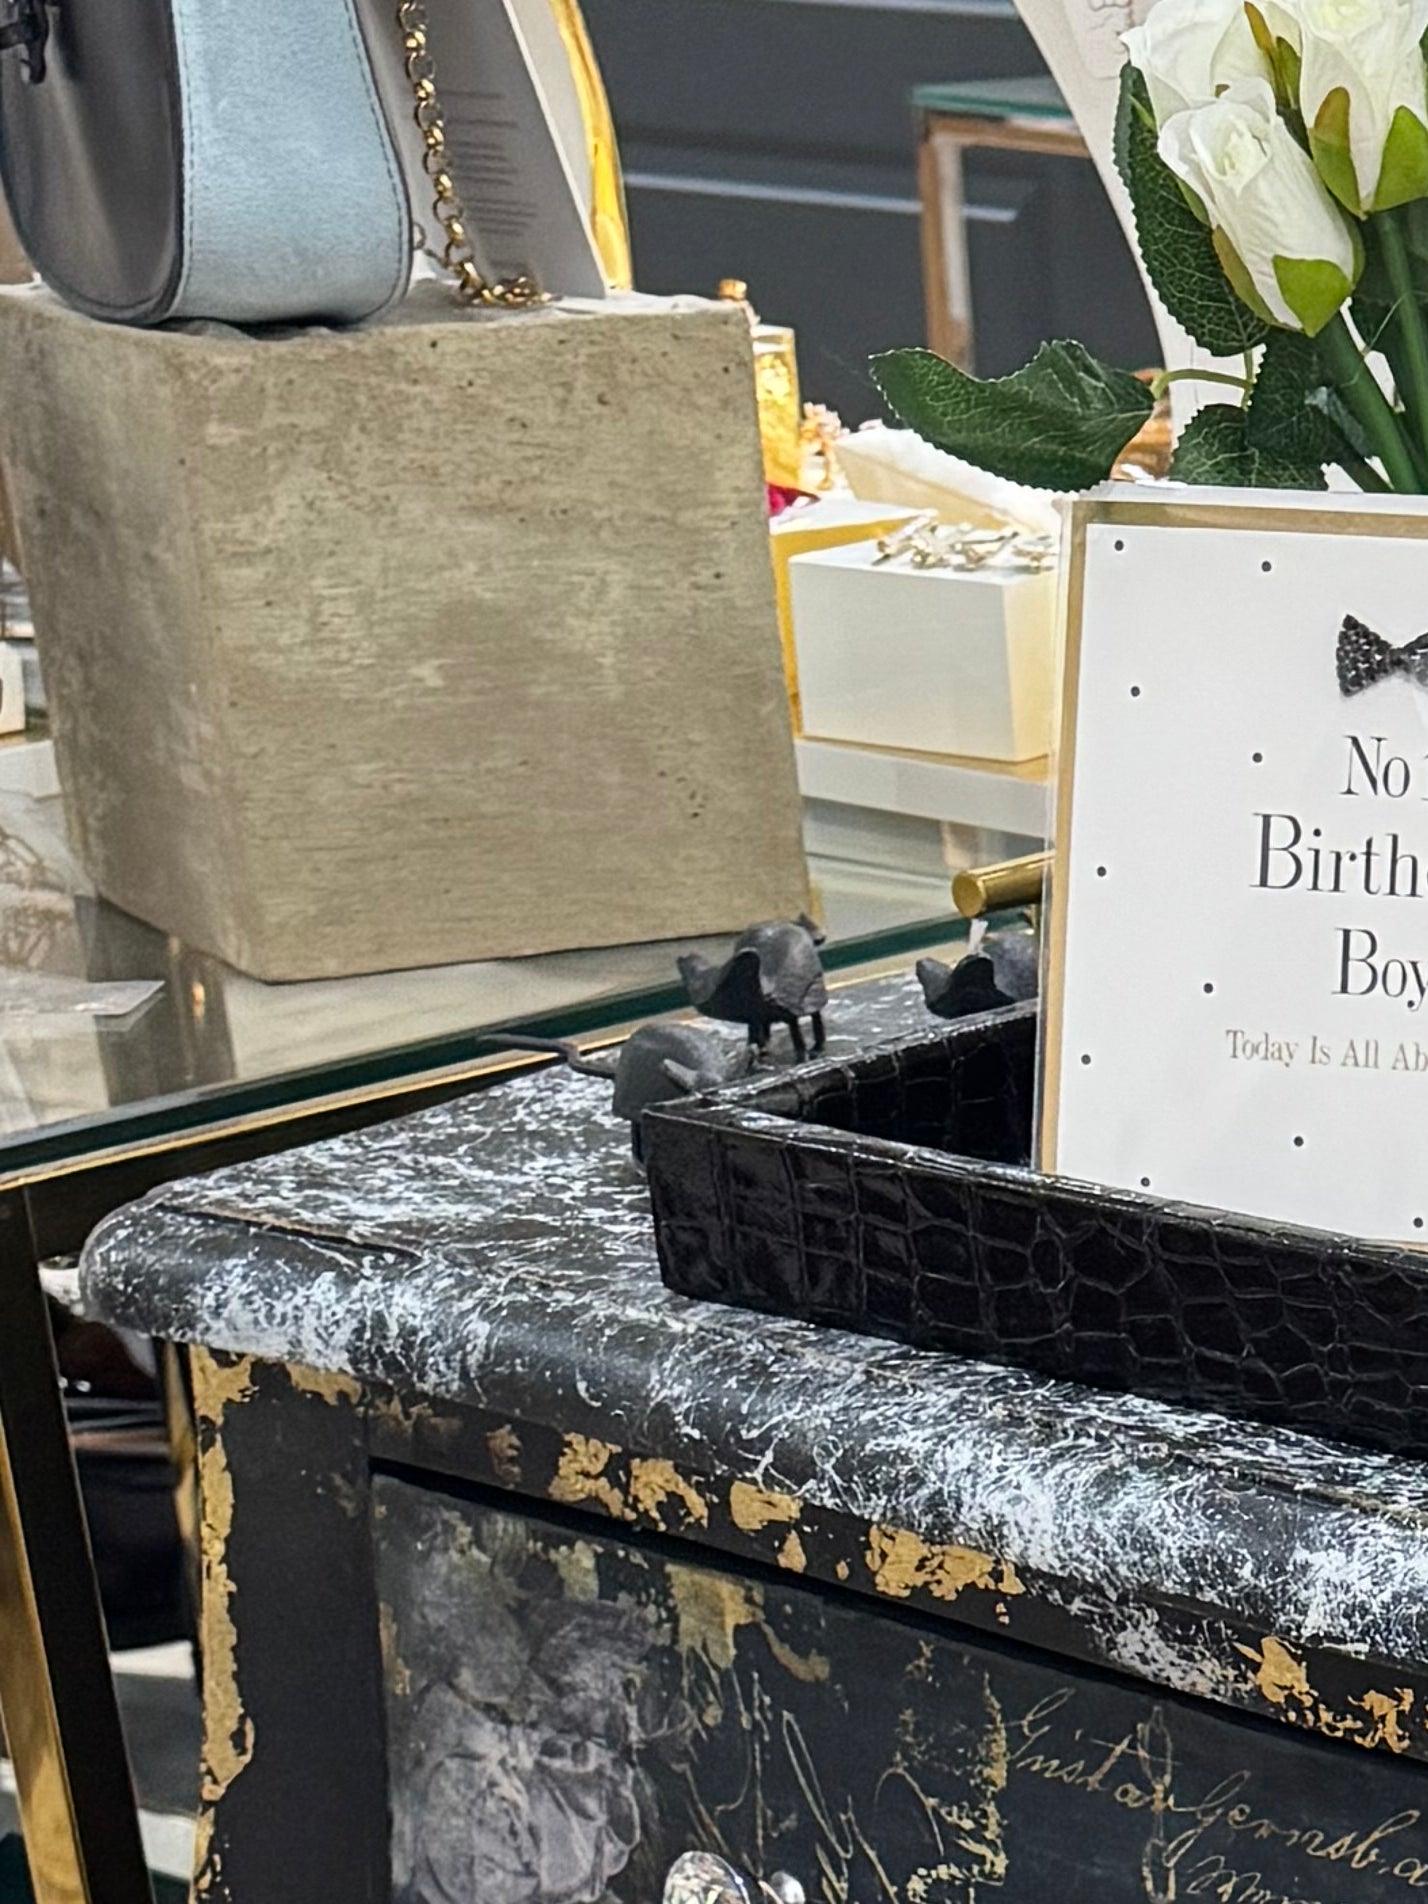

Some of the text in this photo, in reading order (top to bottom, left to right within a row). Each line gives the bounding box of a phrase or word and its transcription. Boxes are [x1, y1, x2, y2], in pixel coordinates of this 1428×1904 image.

[1226, 1029, 1299, 1069] Today
[1310, 1034, 1331, 1067] Is
[1340, 1037, 1380, 1070] All
